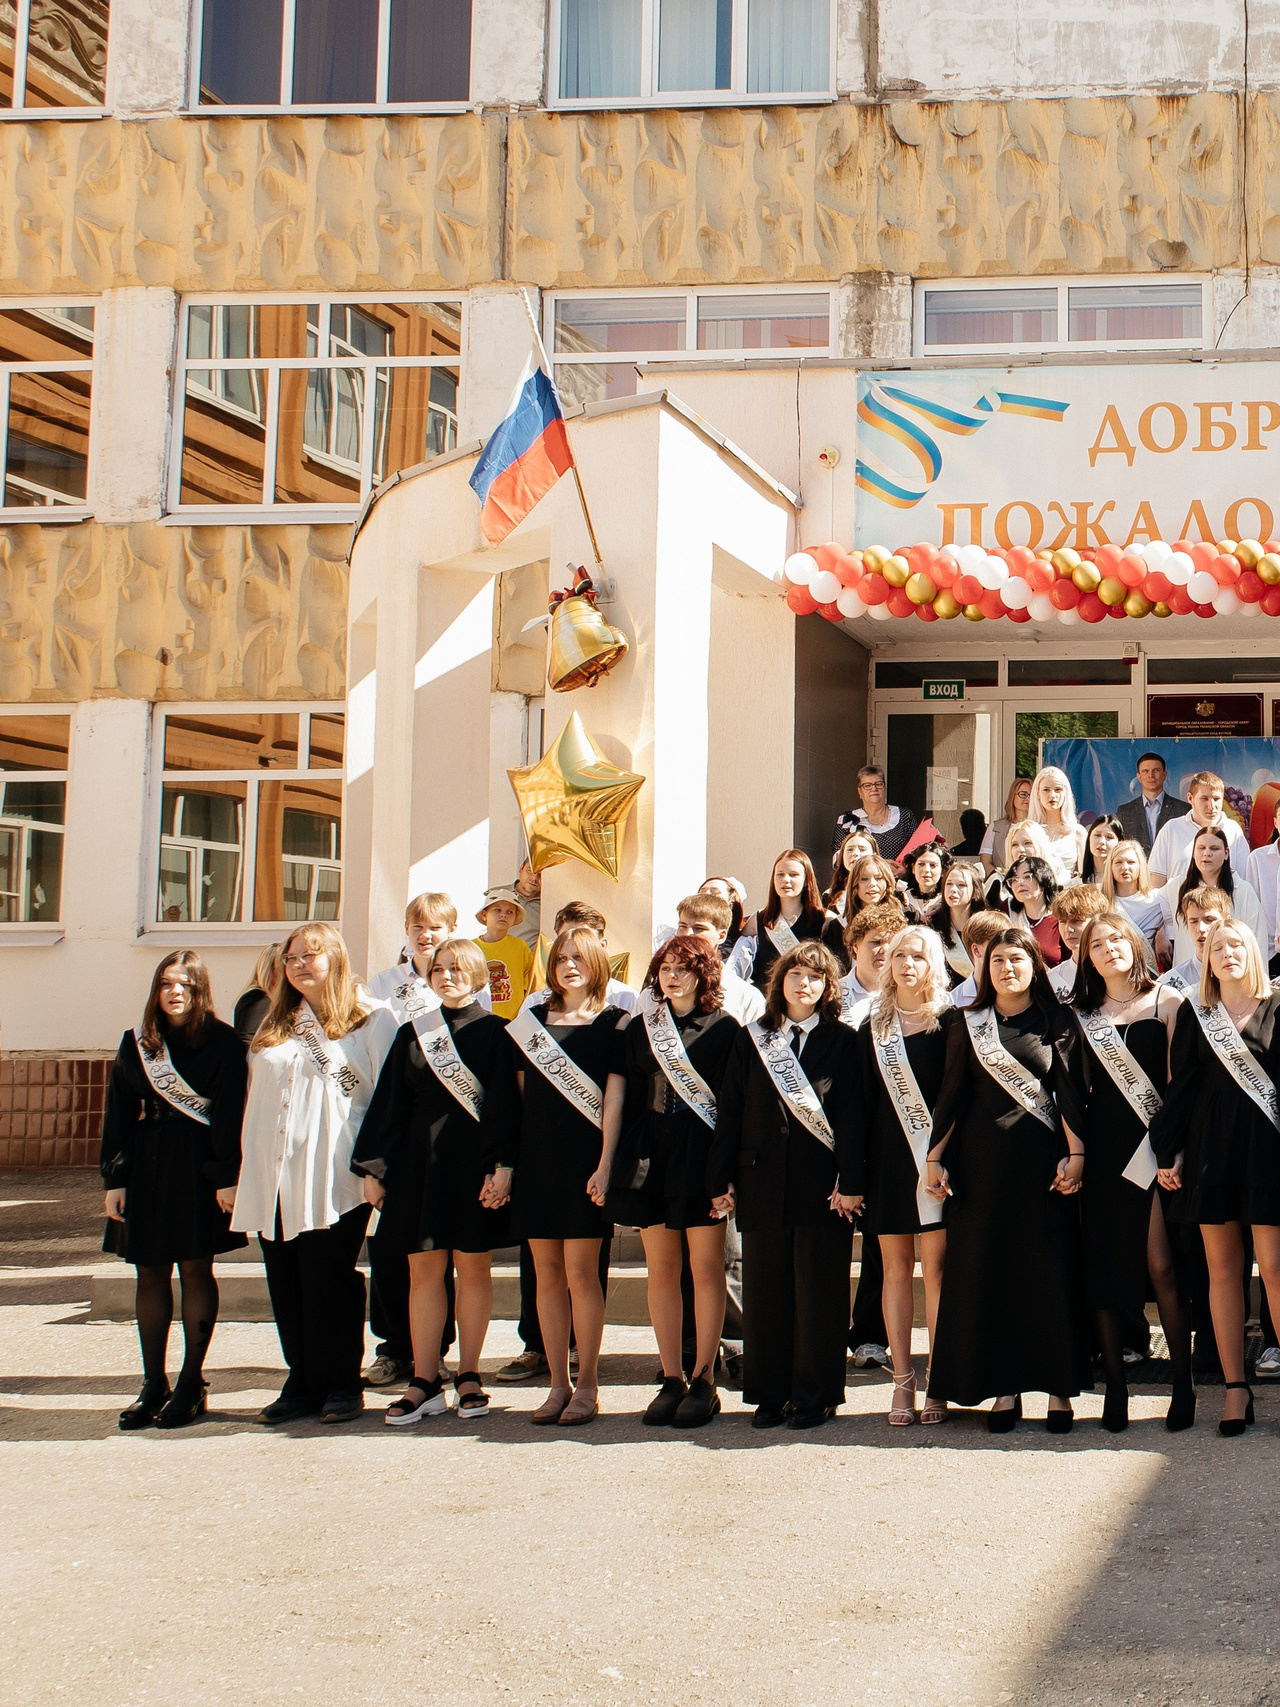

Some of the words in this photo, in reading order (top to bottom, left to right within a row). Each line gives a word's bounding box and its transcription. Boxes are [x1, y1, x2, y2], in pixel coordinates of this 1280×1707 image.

[929, 684, 959, 698] ВХОД
[330, 1065, 360, 1092] 2025
[651, 1028, 702, 1104] Выпускник
[978, 1040, 1040, 1109] Выпускник
[1086, 1018, 1140, 1095] Выпускник
[1206, 1019, 1266, 1095] Выпускница
[904, 1103, 931, 1131] 2025
